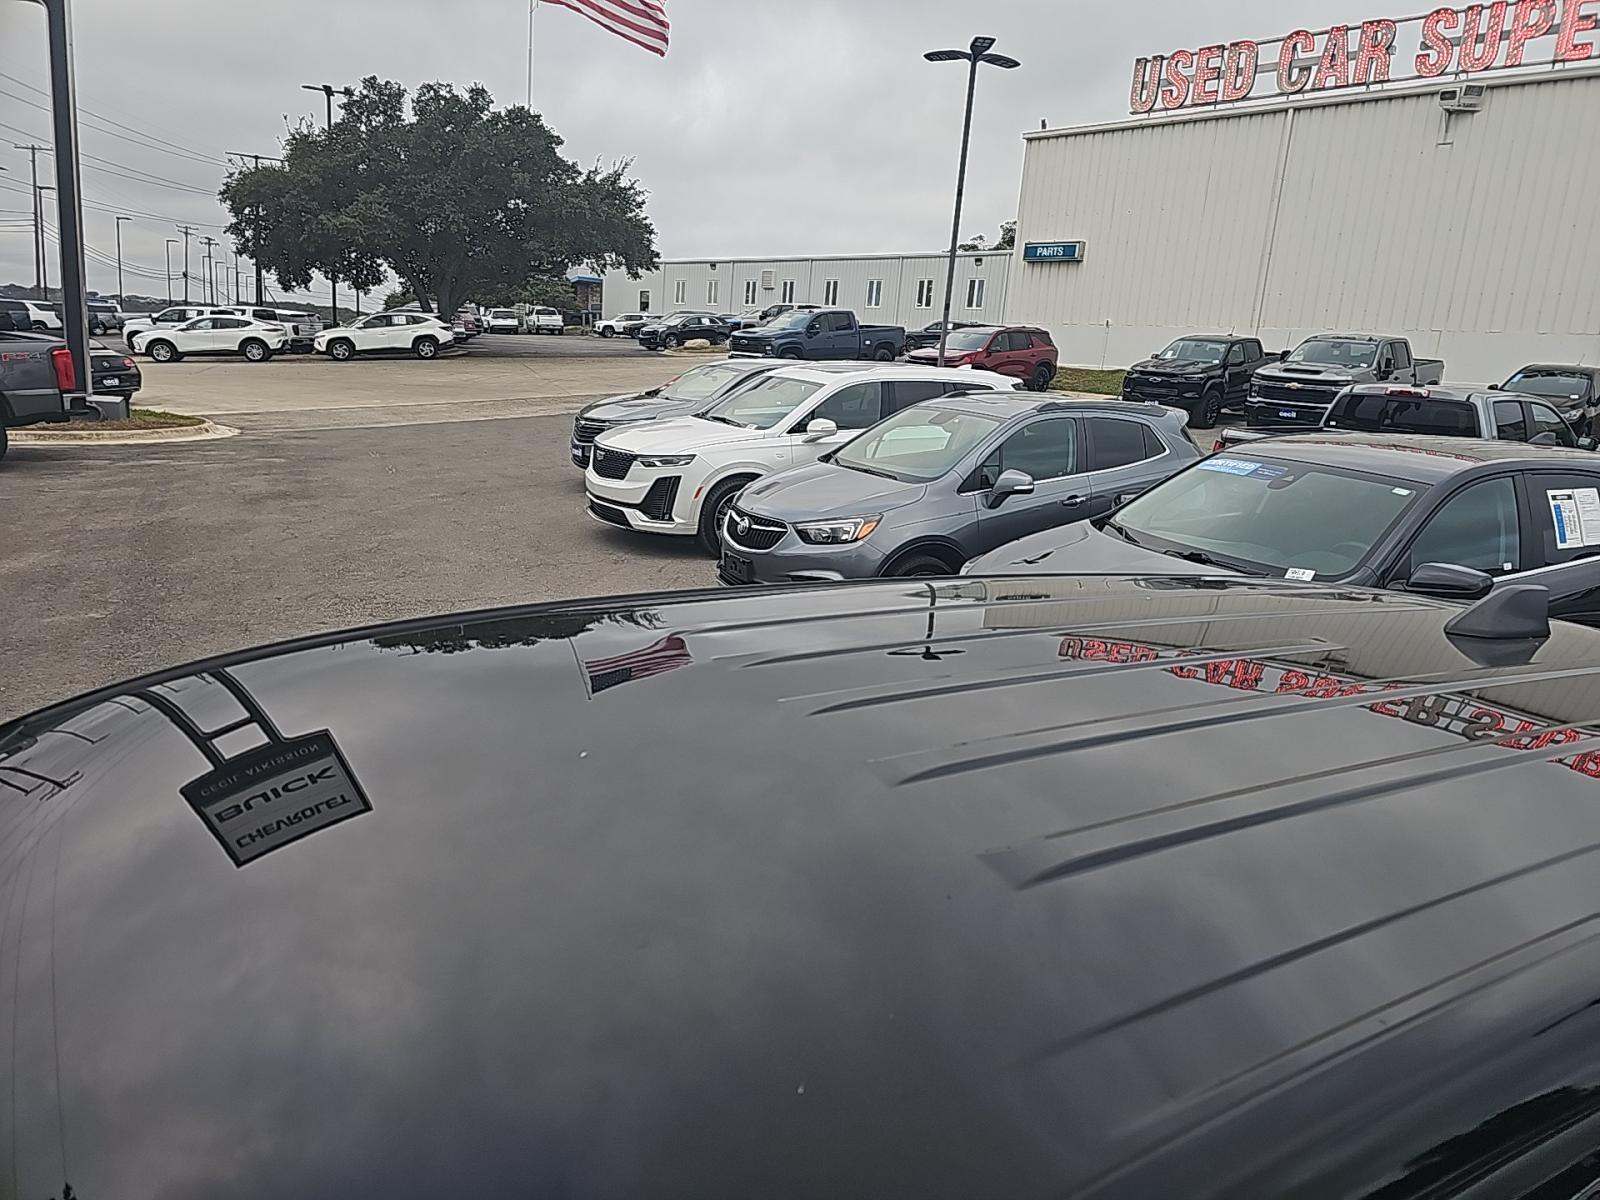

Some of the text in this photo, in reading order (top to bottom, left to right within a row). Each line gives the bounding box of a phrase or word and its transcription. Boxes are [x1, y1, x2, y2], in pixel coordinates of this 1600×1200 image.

[1130, 40, 1258, 112] USED
[1277, 20, 1396, 94] CAR
[1036, 247, 1064, 257] PARTS
